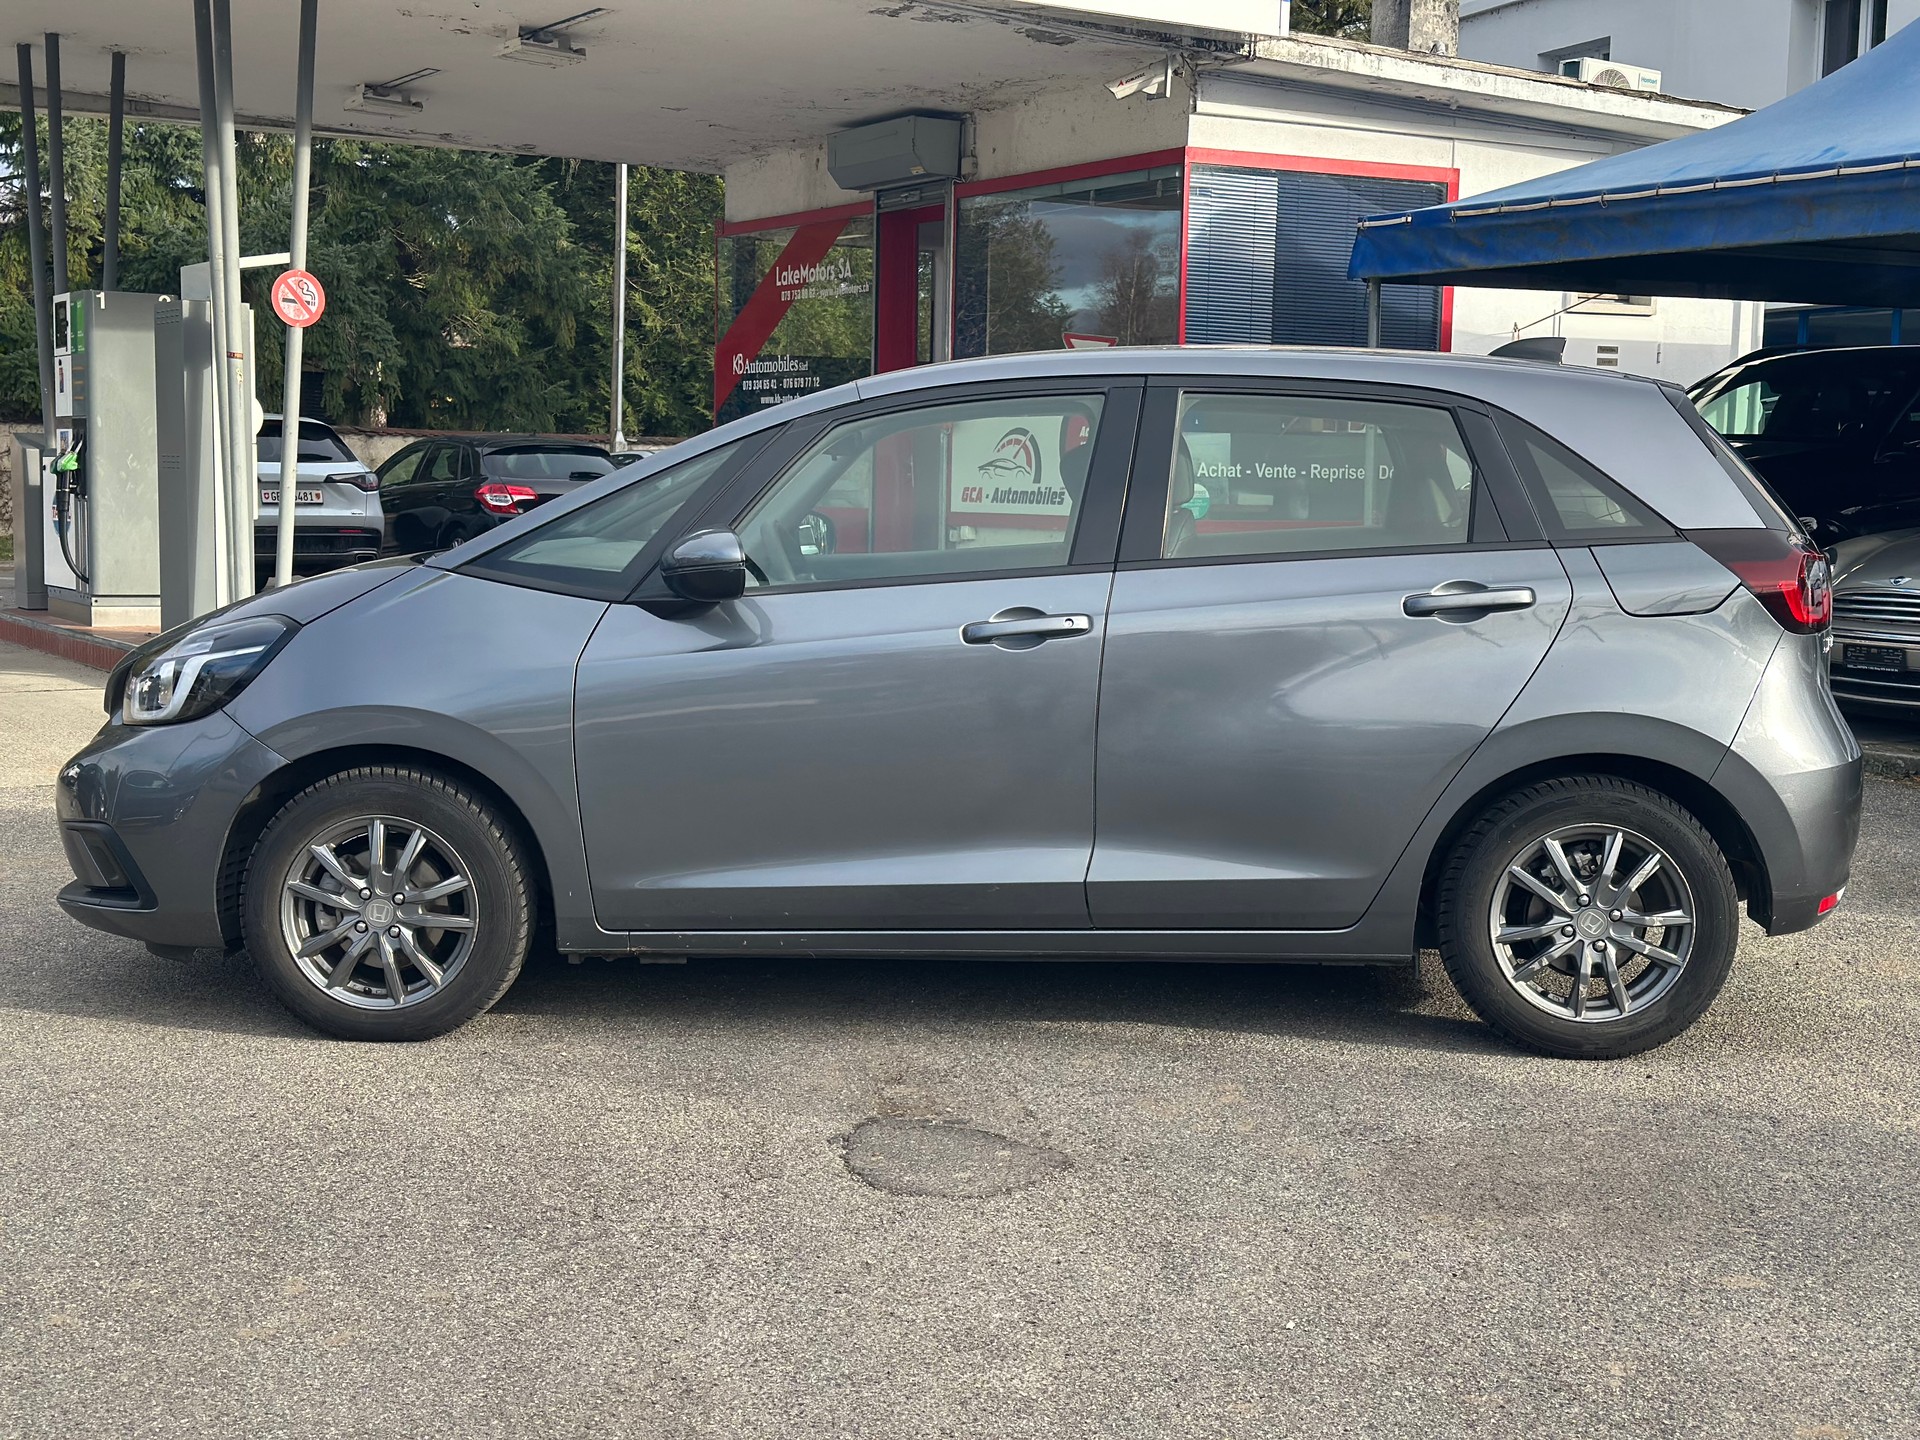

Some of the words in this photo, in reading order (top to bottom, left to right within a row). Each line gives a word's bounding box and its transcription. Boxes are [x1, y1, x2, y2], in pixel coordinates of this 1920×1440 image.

[776, 263, 835, 286] LakeMotors
[838, 258, 852, 279] SA
[95, 291, 106, 310] 1
[742, 380, 752, 391] 079
[783, 378, 793, 389] 076
[812, 376, 821, 387] 12
[1197, 462, 1242, 478] Achat
[1255, 462, 1296, 479] Vente
[1310, 463, 1366, 483] Reprise
[961, 487, 983, 503] GCA
[990, 486, 1066, 505] Automobiles
